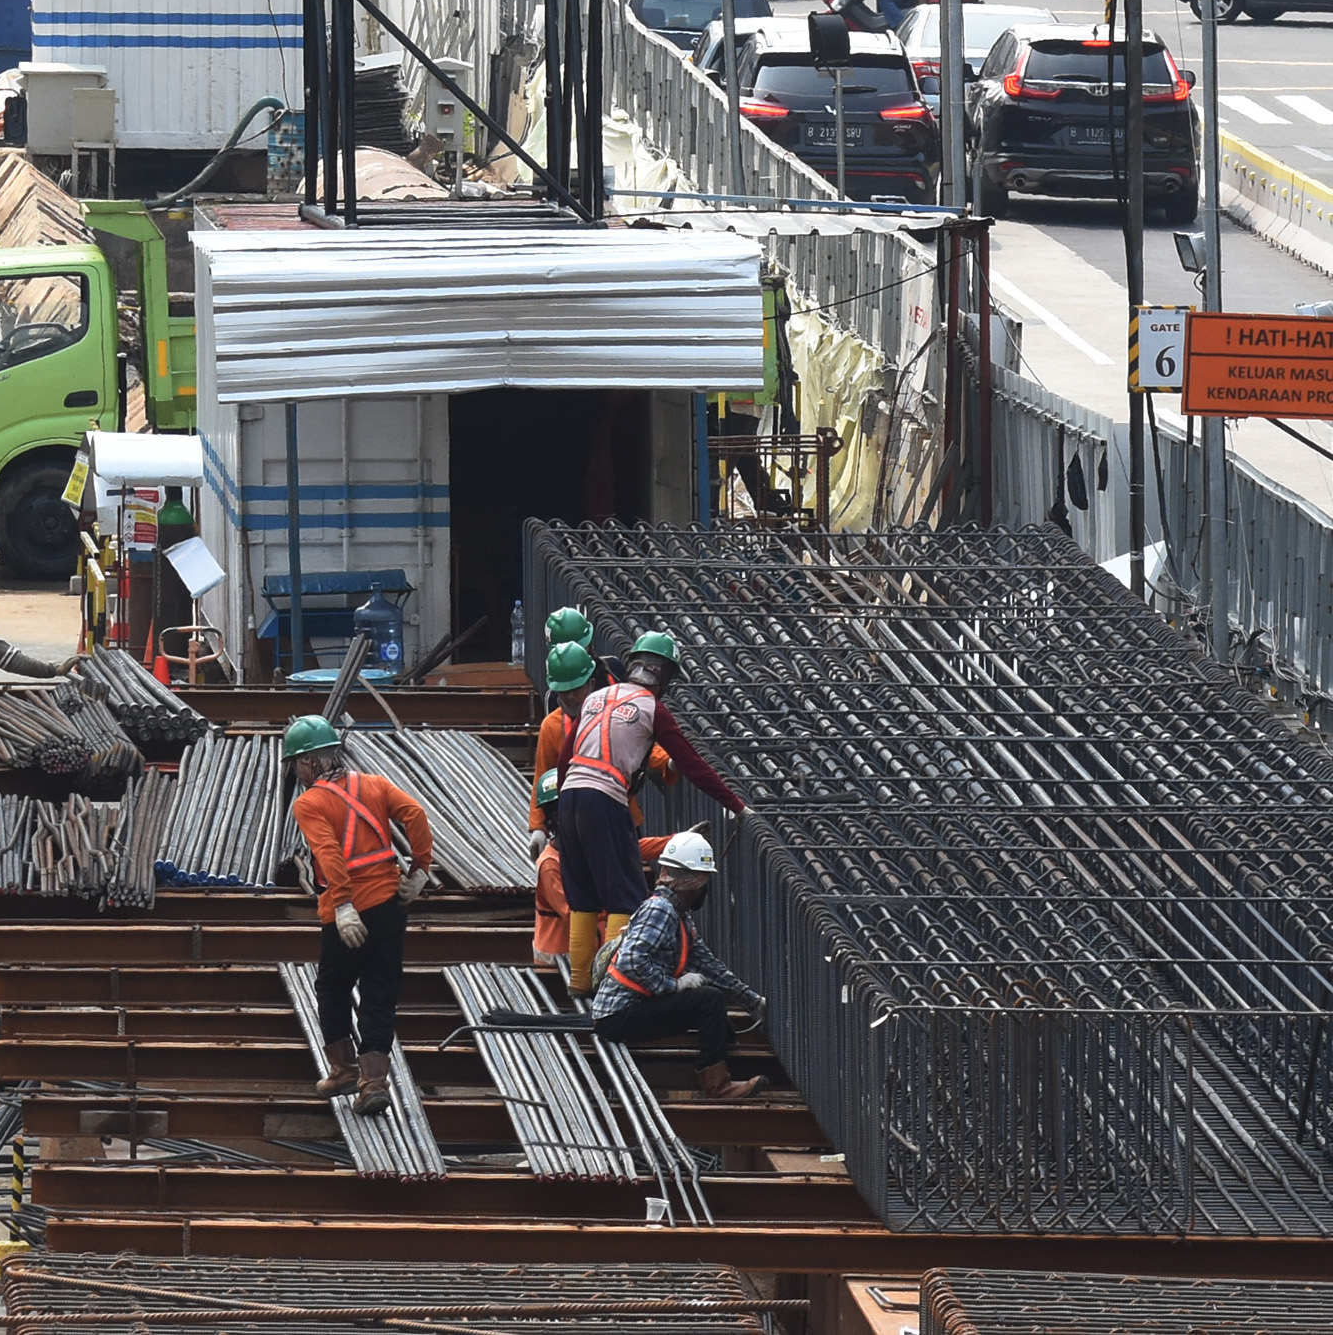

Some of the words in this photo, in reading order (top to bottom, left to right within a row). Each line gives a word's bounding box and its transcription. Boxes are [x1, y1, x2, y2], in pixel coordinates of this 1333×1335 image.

[808, 128, 814, 137] B
[820, 128, 838, 138] 213
[1070, 128, 1077, 137] B
[1150, 323, 1180, 332] GATE
[1155, 345, 1176, 377] 6
[1228, 366, 1285, 380] KELUAR
[1207, 386, 1301, 402] KENDARAAN
